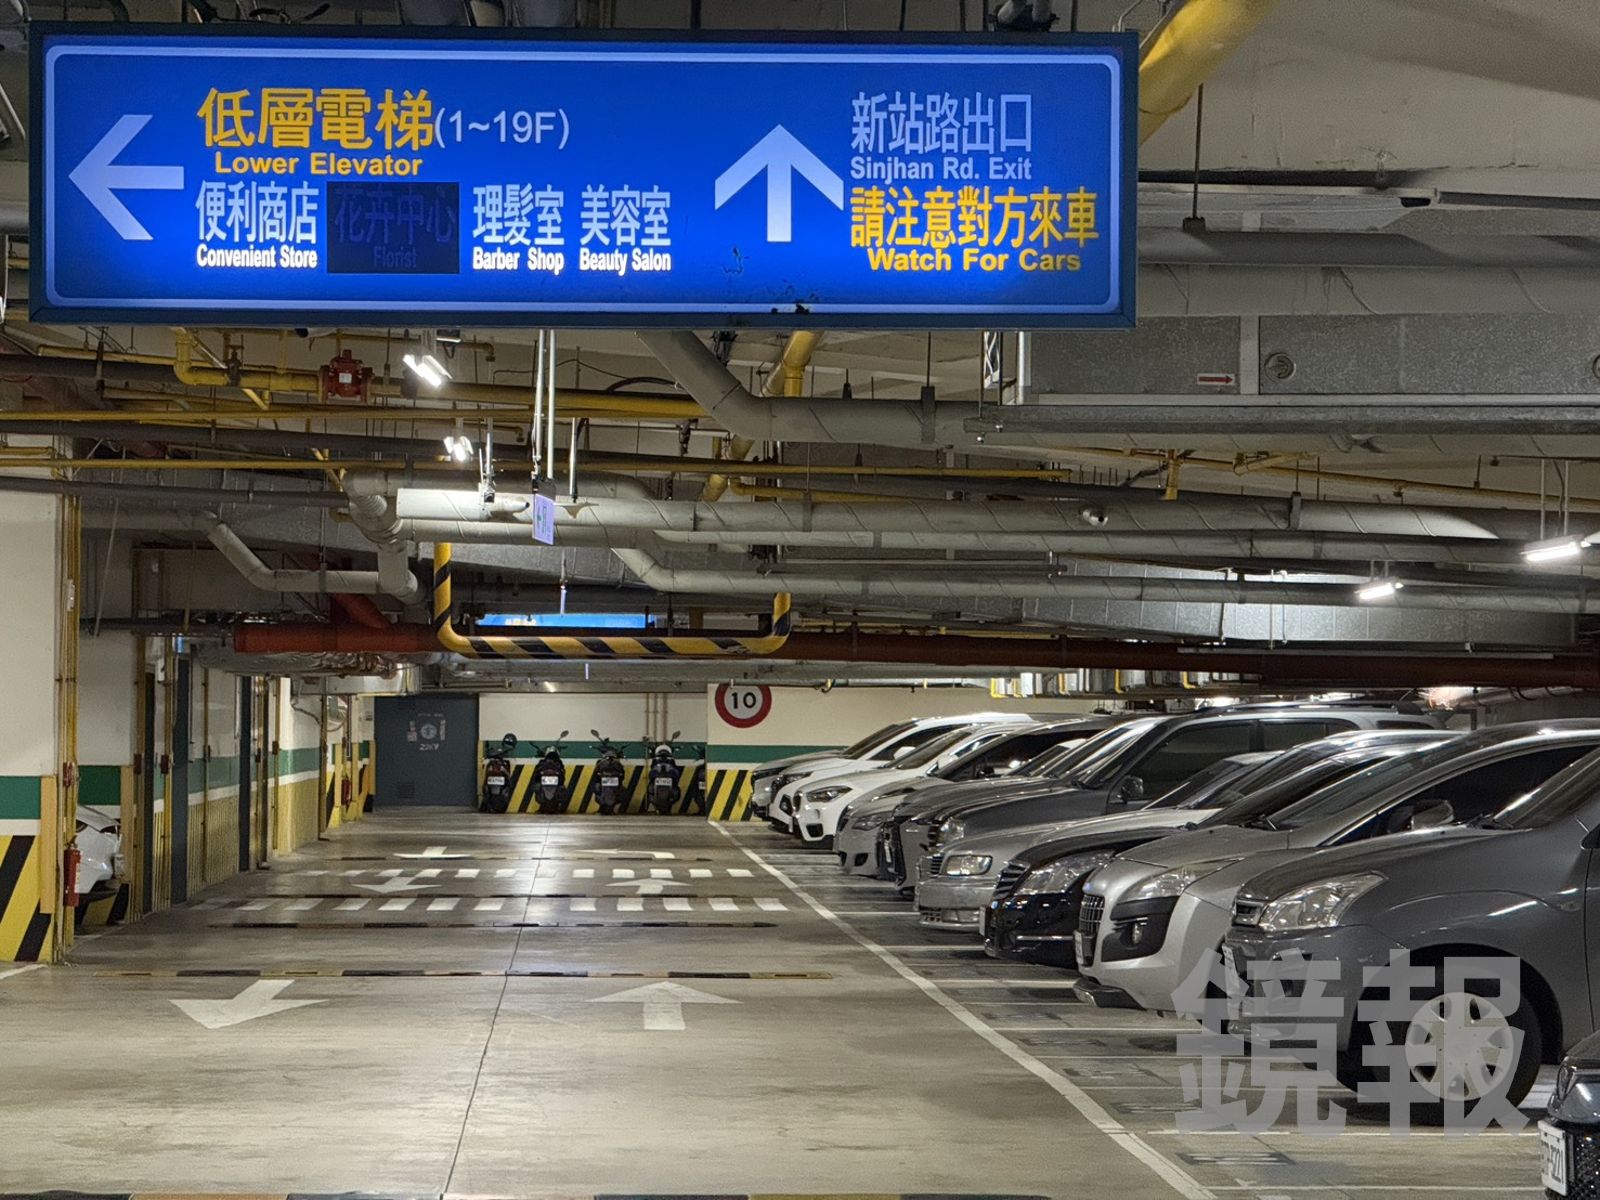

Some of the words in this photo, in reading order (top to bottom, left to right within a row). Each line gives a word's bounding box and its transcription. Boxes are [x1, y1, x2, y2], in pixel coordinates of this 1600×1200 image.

[197, 87, 433, 151] 低層電梯
[434, 108, 570, 150] (1~19F)
[851, 91, 1032, 154] 新站路出口
[215, 151, 299, 174] Lower
[310, 152, 423, 176] Elevator
[850, 156, 934, 185] Sinjhan
[943, 157, 980, 180] Rd.
[989, 157, 1032, 180] Exit
[195, 180, 319, 244] 便利商店
[472, 183, 565, 246] 理髮室
[580, 184, 671, 246] 美容室
[850, 185, 1099, 249] 請注意對方來車
[196, 243, 277, 268] Convenient
[279, 244, 319, 269] Store
[472, 246, 520, 270] Barber
[527, 247, 565, 275] Shop
[579, 247, 628, 276] Beauty
[630, 248, 672, 272] Salon
[867, 247, 952, 272] Watch
[962, 248, 1010, 272] For
[1018, 248, 1082, 272] Cars
[731, 692, 757, 709] 10
